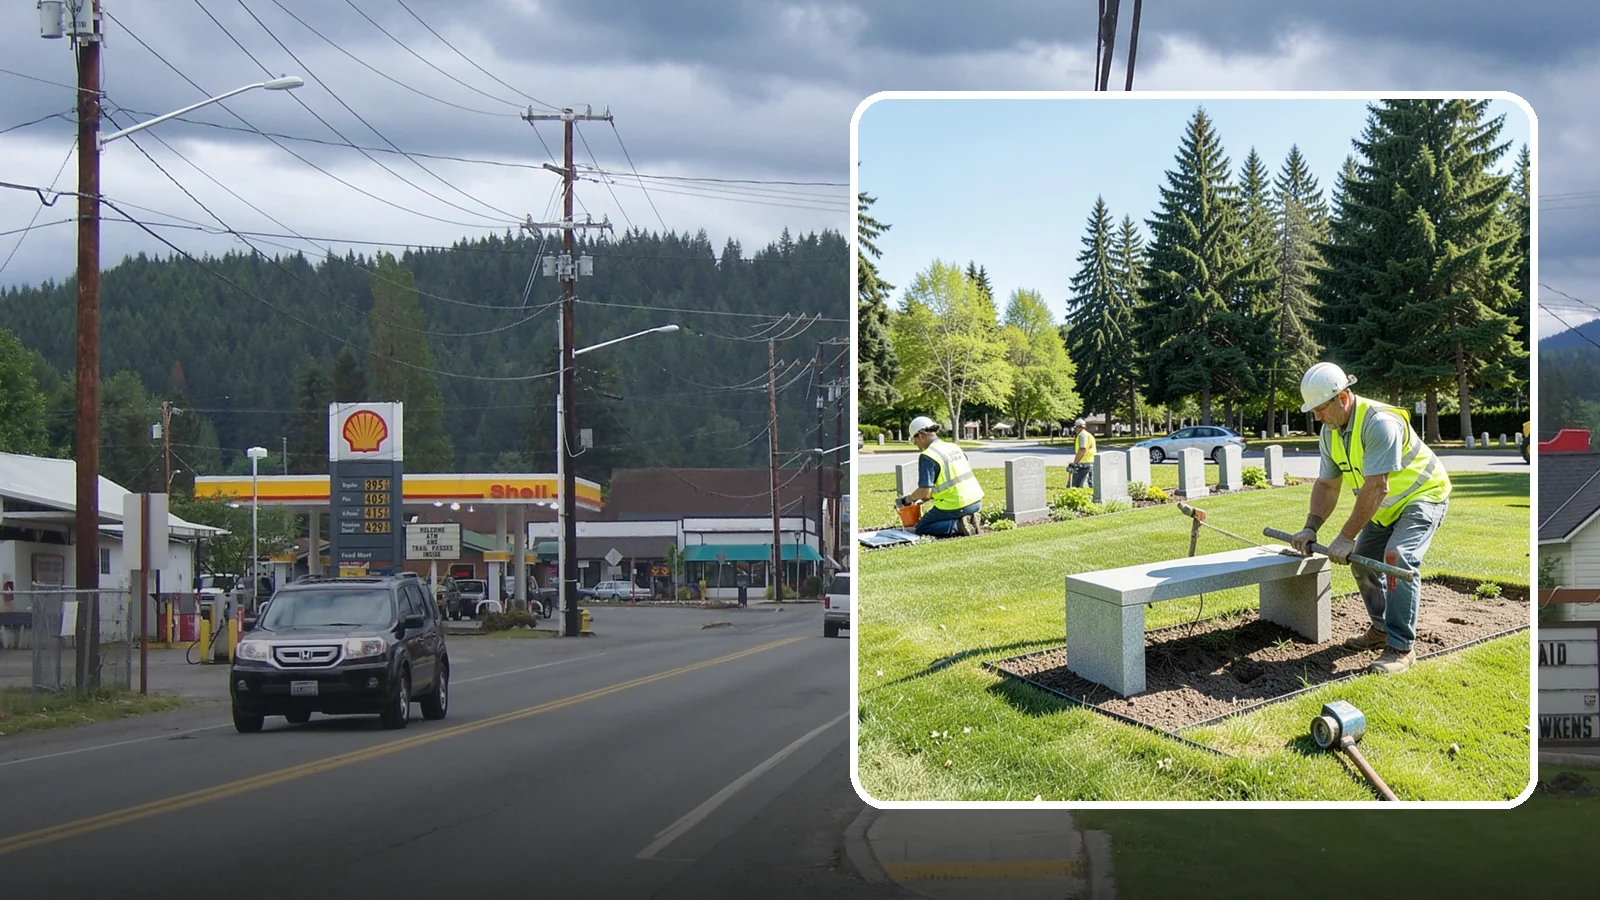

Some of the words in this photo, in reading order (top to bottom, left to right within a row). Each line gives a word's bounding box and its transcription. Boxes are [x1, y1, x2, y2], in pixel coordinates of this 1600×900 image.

[366, 480, 384, 490] 395
[490, 484, 547, 498] Shell
[366, 494, 384, 504] 405
[366, 508, 383, 518] 415
[366, 522, 384, 532] 429
[1538, 643, 1566, 665] AID
